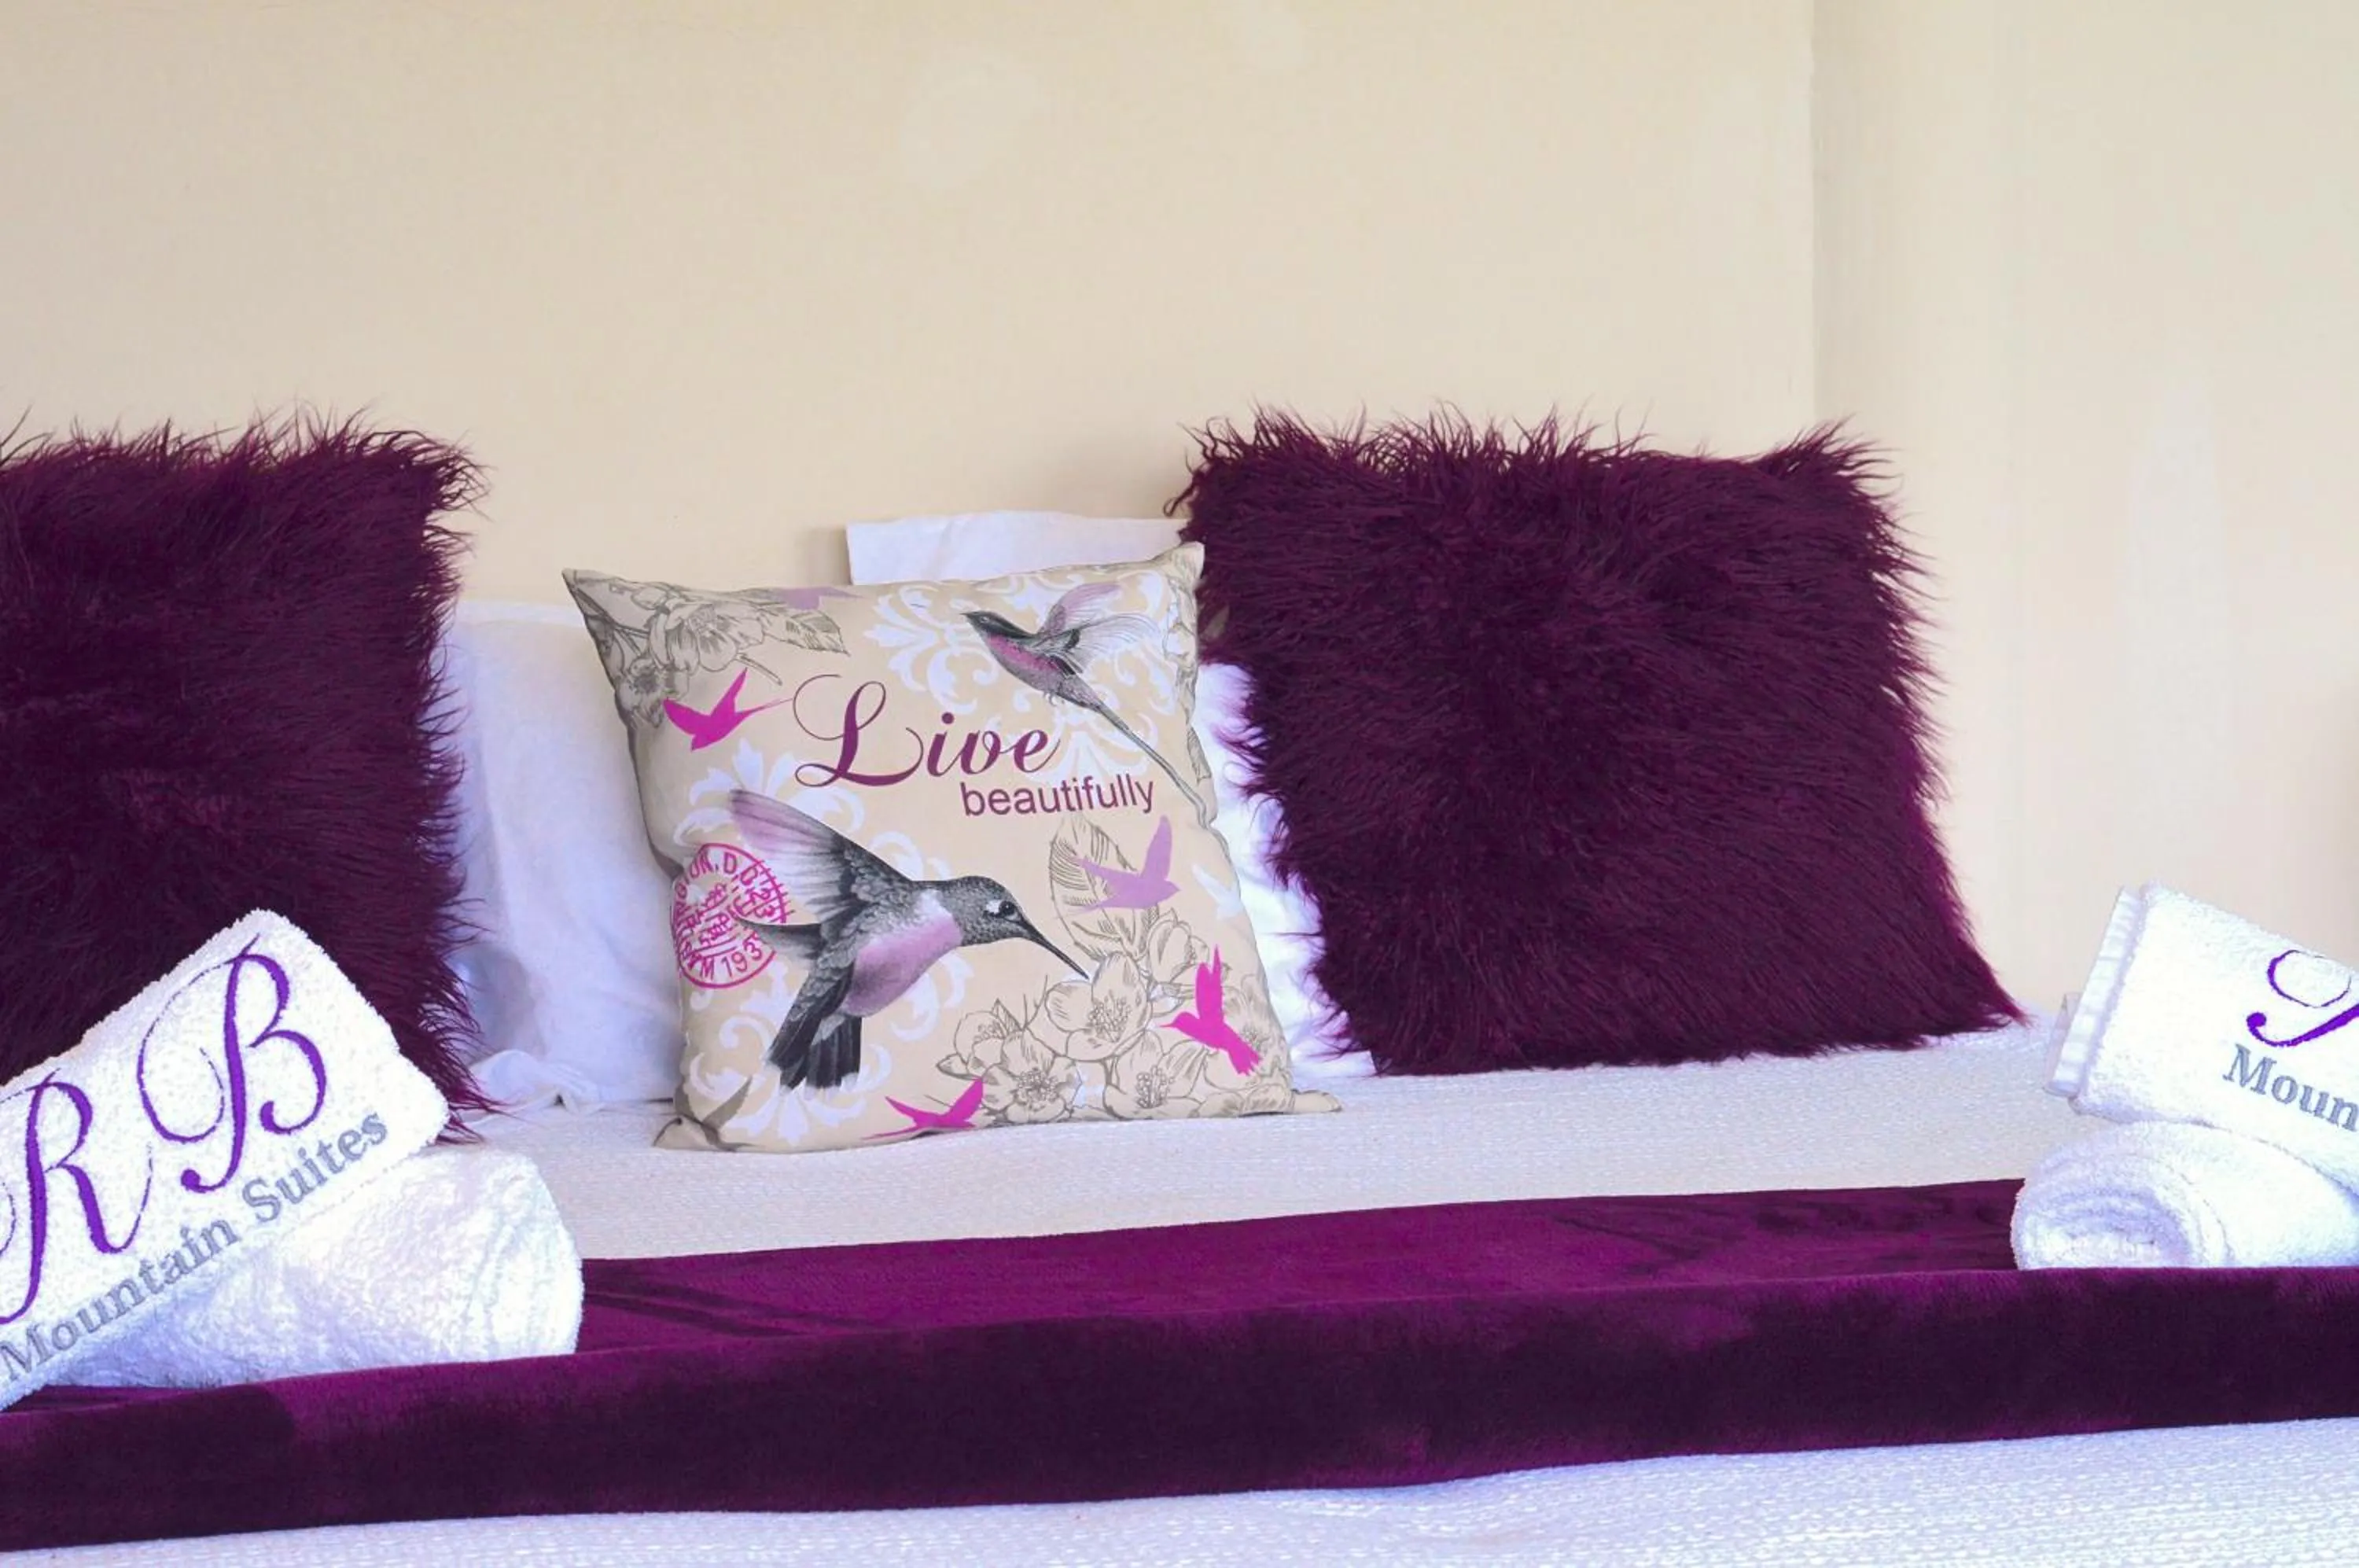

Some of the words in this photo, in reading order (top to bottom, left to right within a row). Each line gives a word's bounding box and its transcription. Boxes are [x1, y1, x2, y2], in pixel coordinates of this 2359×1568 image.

[793, 674, 1061, 787] Live
[960, 773, 1154, 816] beautifully
[0, 1218, 242, 1383] Mountain
[241, 1111, 388, 1223] Suites
